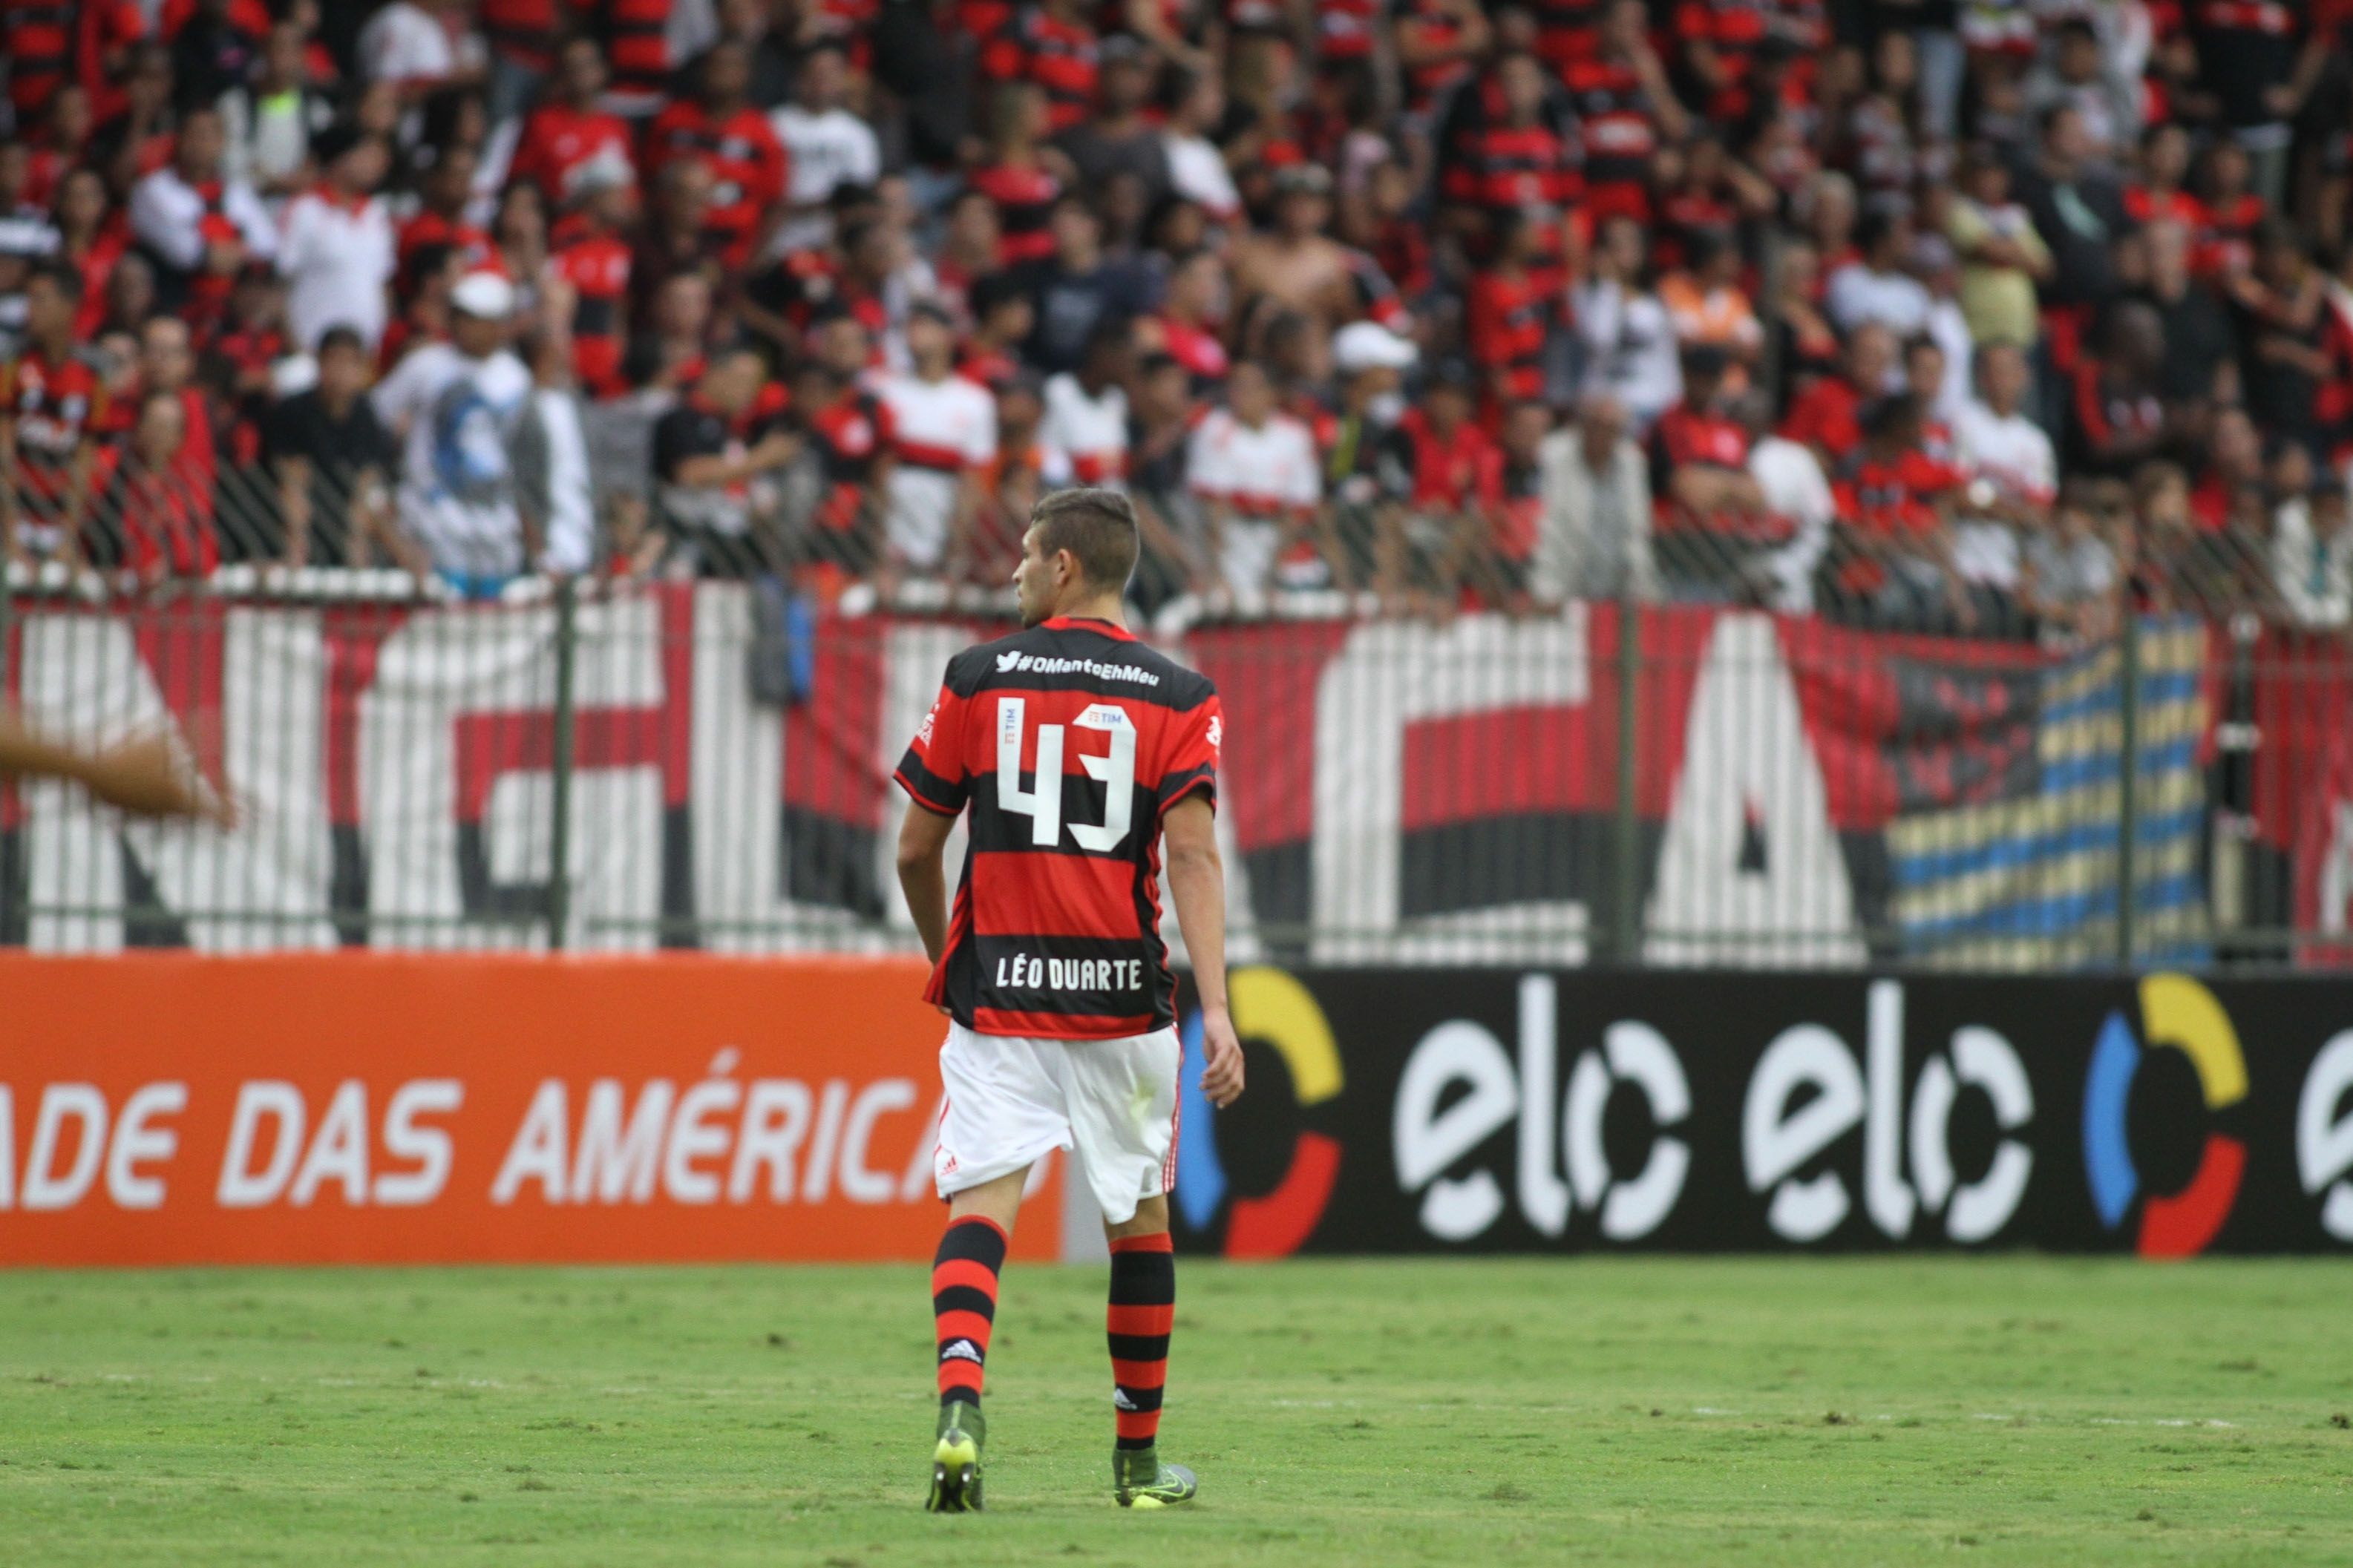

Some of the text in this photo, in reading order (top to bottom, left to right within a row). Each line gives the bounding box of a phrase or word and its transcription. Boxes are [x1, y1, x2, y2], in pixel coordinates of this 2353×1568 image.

[1006, 708, 1015, 730] TIM
[1016, 655, 1160, 687] #OMantoEhMeu
[1102, 712, 1122, 724] TIM
[998, 697, 1137, 852] 43
[996, 953, 1142, 991] LÉO DUARTE
[217, 1077, 465, 1207] DAS
[488, 1046, 1052, 1205] AMÉRIC
[1392, 973, 1692, 1241] elo
[1741, 977, 2035, 1244] elo
